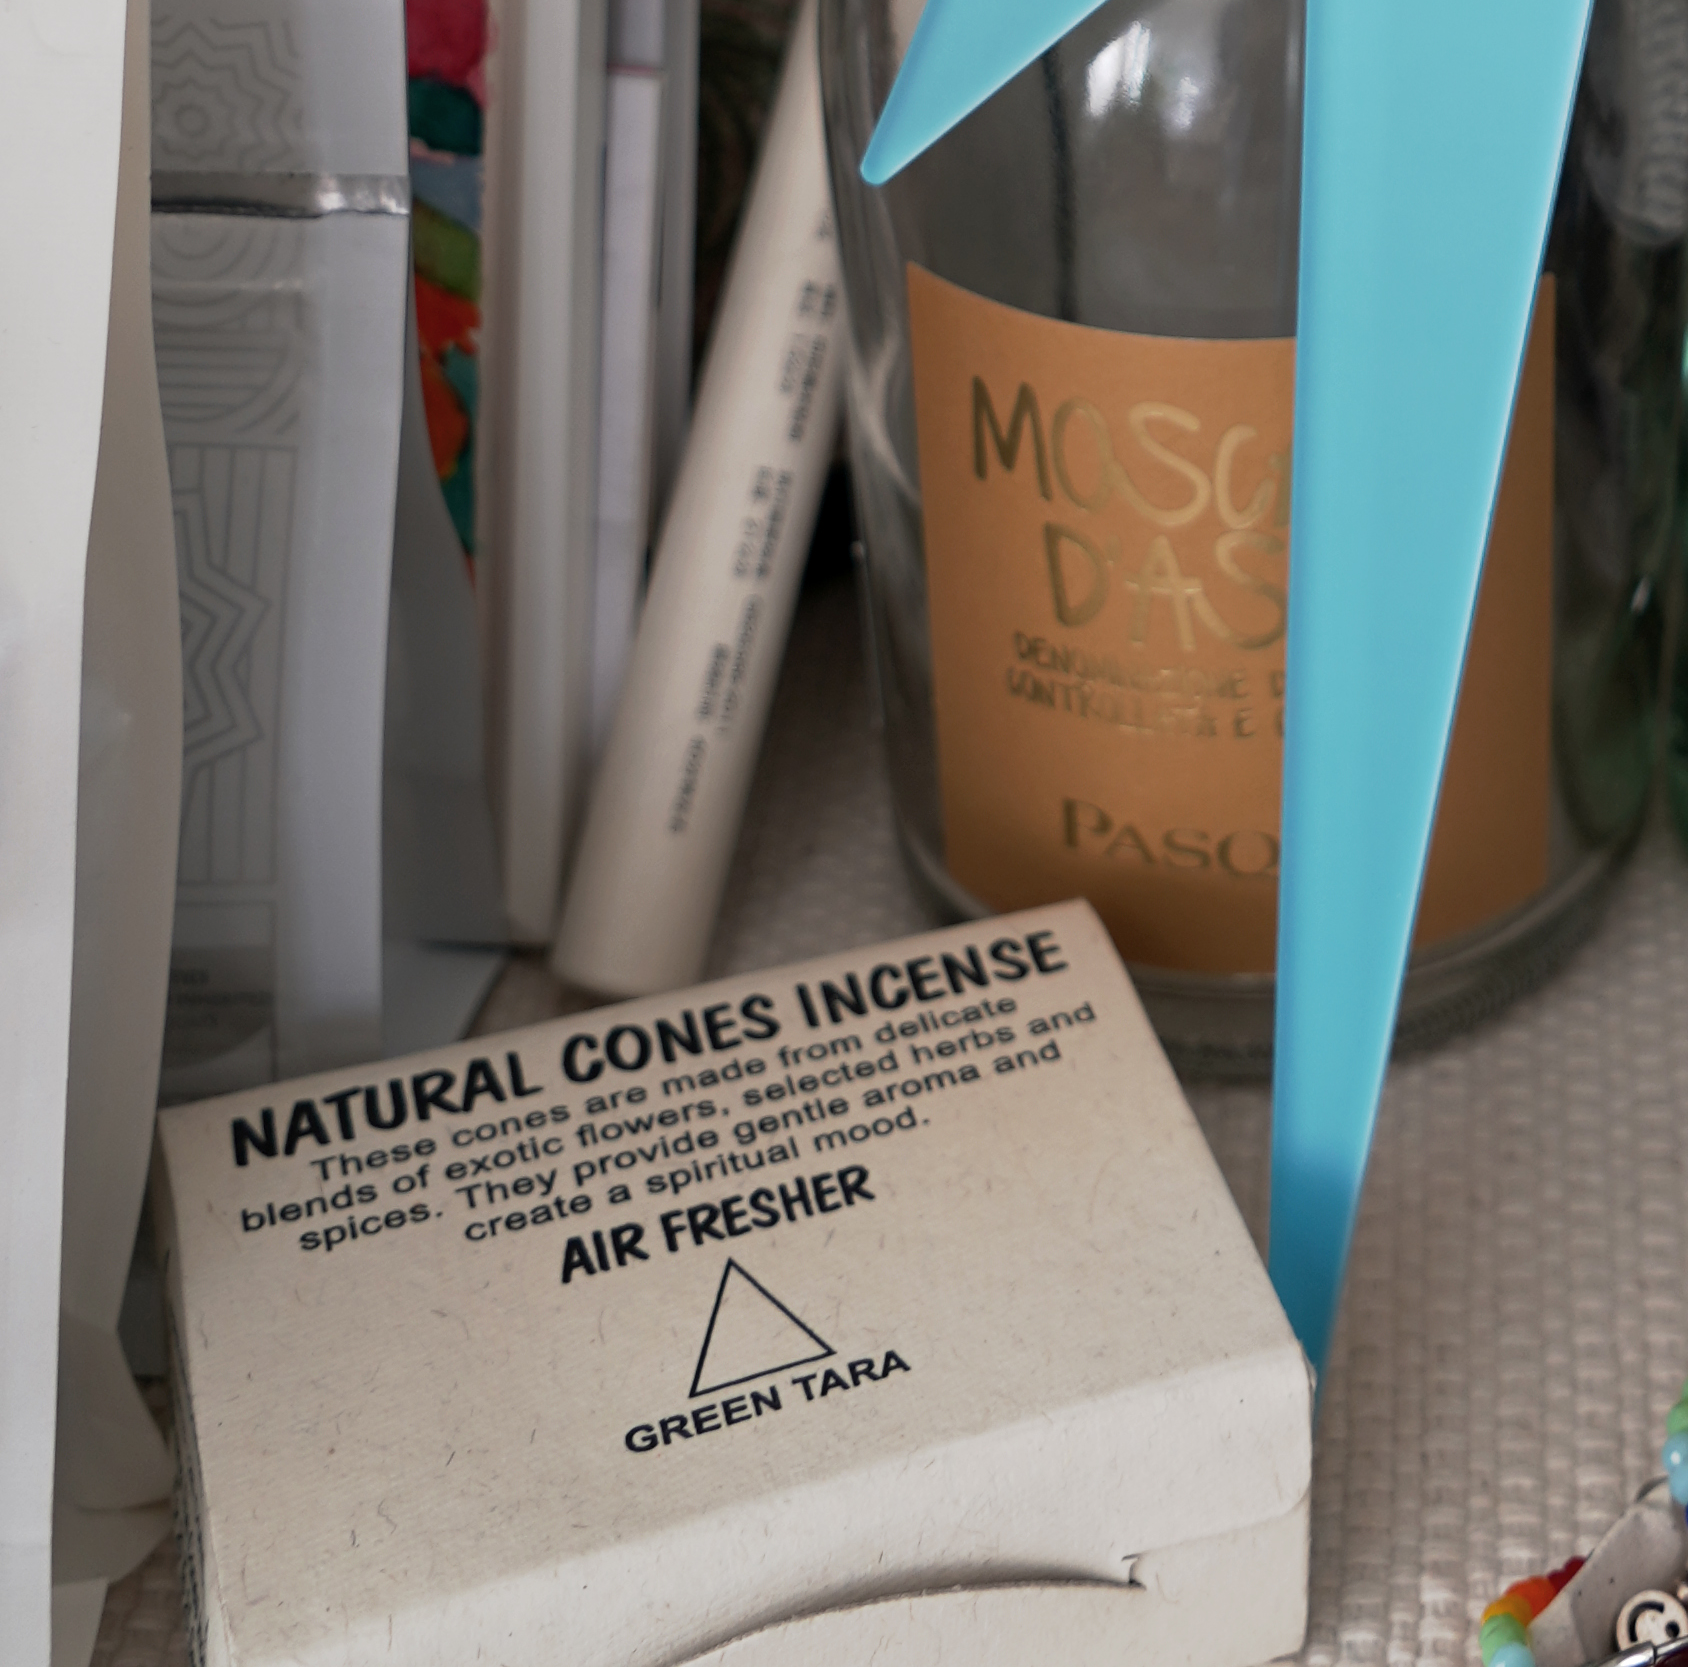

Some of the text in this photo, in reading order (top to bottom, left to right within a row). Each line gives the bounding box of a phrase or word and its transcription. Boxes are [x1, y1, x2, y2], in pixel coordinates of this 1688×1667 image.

[971, 373, 1293, 532] MOSC
[232, 930, 1069, 1166] NATURAL CONES INCENSE
[242, 1001, 1097, 1233] blends of exotic flowers, selected herbs and
[311, 994, 1017, 1182] These cones are made from delicate
[300, 1039, 1062, 1252] spices. They provide gentle aroma and
[464, 1105, 931, 1243] create a spiritual mood.
[561, 1163, 876, 1285] AIR FRESHER
[624, 1348, 912, 1453] GREEN TARA
